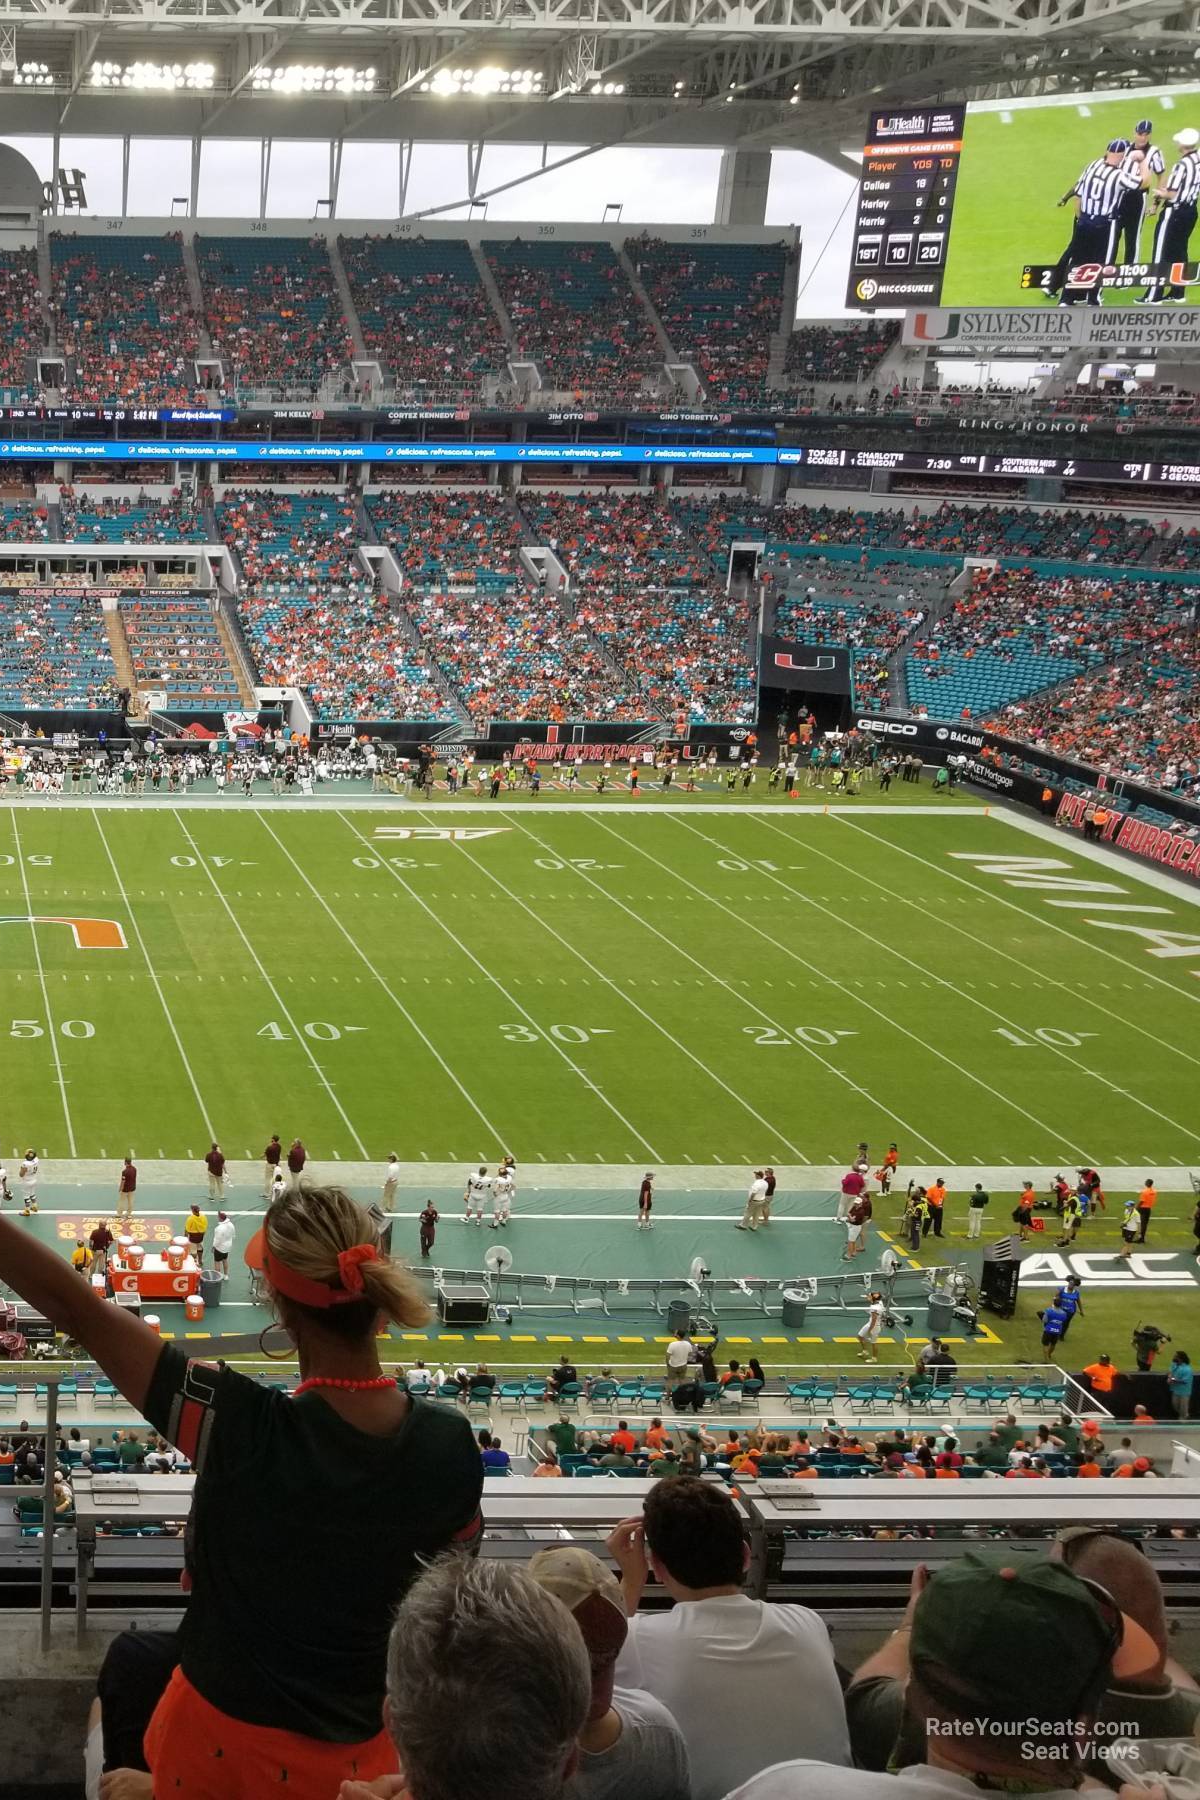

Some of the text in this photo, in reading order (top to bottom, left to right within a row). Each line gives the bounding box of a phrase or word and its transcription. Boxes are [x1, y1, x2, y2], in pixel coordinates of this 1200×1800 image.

[868, 162, 896, 172] Player
[912, 160, 932, 169] YDS
[864, 181, 890, 191] Dallas
[939, 196, 946, 206] 0
[913, 214, 944, 225] 2 0
[859, 246, 938, 260] 1ST 10 20
[1041, 265, 1148, 285] 2 11:00
[878, 284, 934, 294] MICCOSUKEE
[961, 312, 1199, 333] SYLVESTER UNIVERSITY OF
[1089, 330, 1144, 342] HEALTH
[115, 412, 125, 420] 20
[960, 419, 1088, 432] RING HONOR
[807, 457, 839, 466] SCORES
[856, 459, 896, 467] CLEMSON
[1002, 466, 1044, 474] ALABAMA
[1063, 468, 1075, 476] 49
[808, 450, 826, 458] TOP
[857, 452, 904, 460] CHARLOTTE
[926, 460, 952, 470] 7:30
[960, 456, 976, 464] QTR
[1002, 458, 1038, 466] SOUTHERN
[1040, 460, 1056, 468] MISS
[857, 719, 918, 736] GEICO
[10, 1018, 96, 1038] 50
[256, 1020, 342, 1041] 40
[498, 1022, 590, 1043] 30
[742, 1026, 840, 1046] 20
[992, 1027, 1082, 1047] 10
[1018, 1252, 1194, 1280] ACC
[122, 1275, 189, 1292] G G
